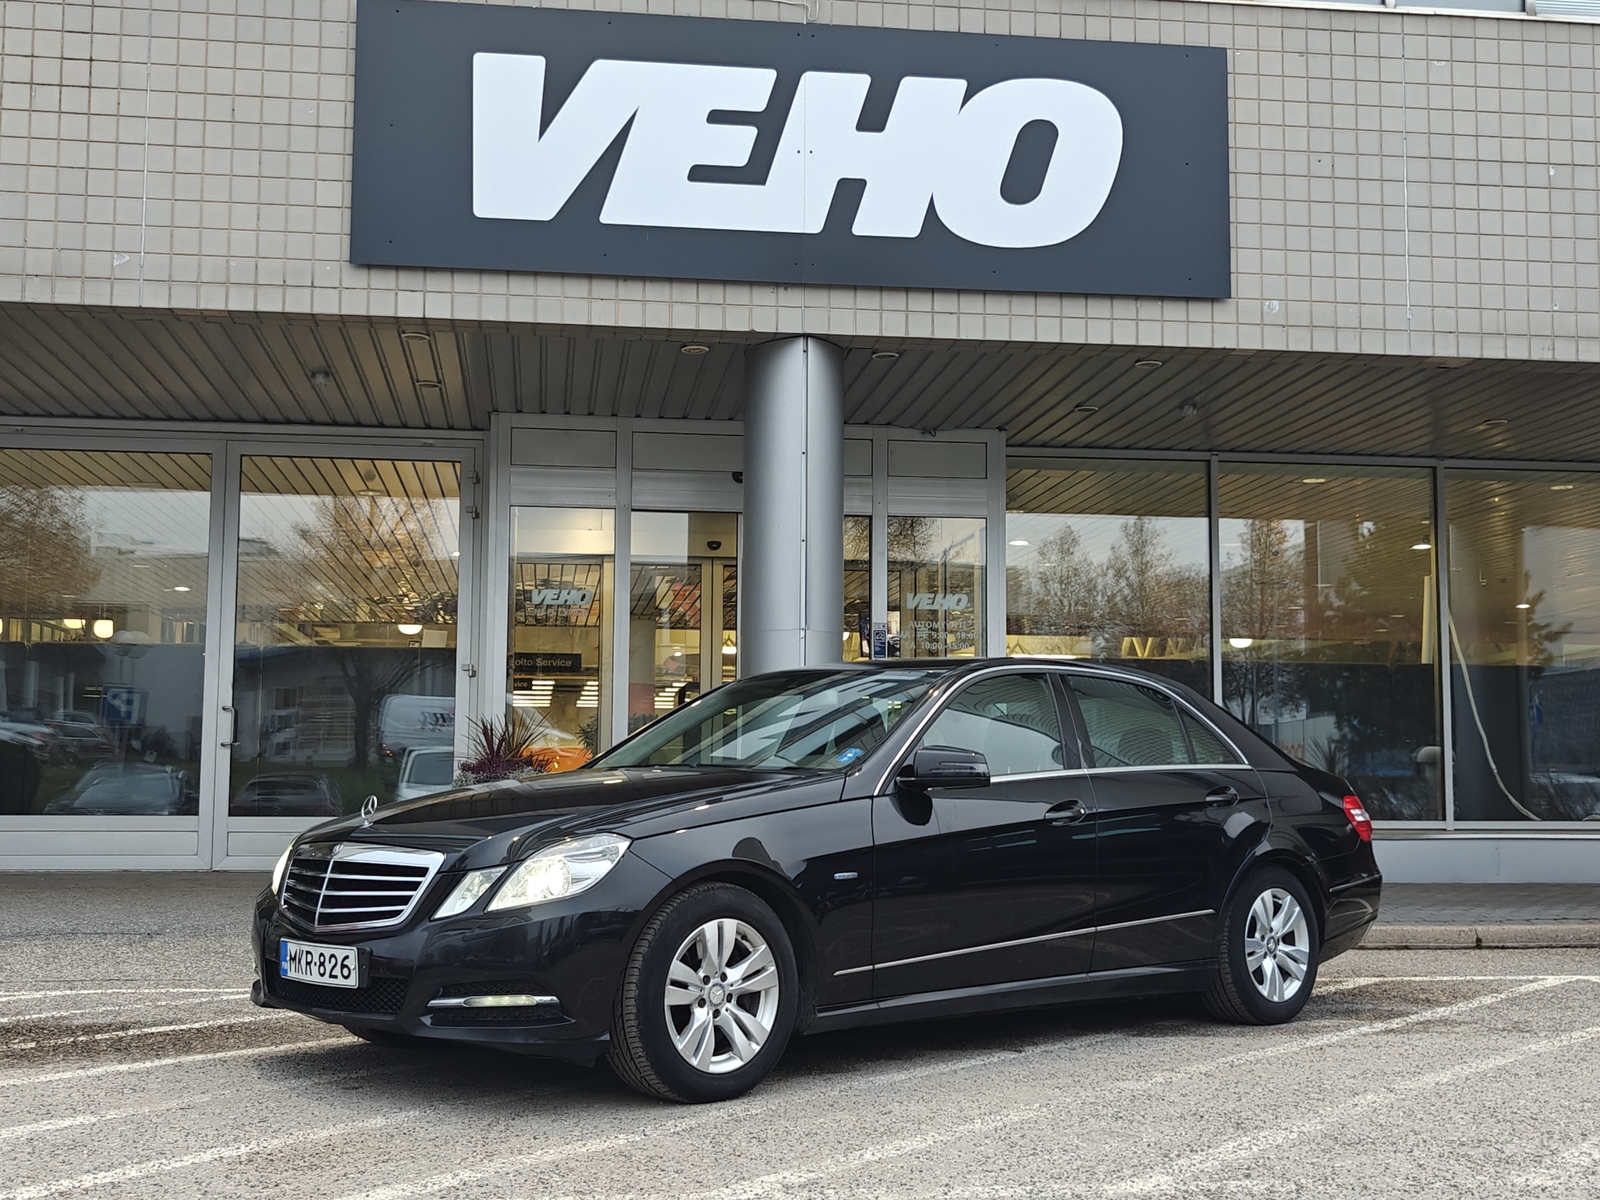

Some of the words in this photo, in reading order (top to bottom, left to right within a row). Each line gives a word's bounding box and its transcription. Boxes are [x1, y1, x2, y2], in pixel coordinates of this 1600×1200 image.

[472, 52, 1124, 249] VEHO
[531, 588, 593, 606] VEHO
[906, 593, 969, 610] VEHO
[535, 656, 572, 667] Service
[288, 947, 352, 981] MKR-826
